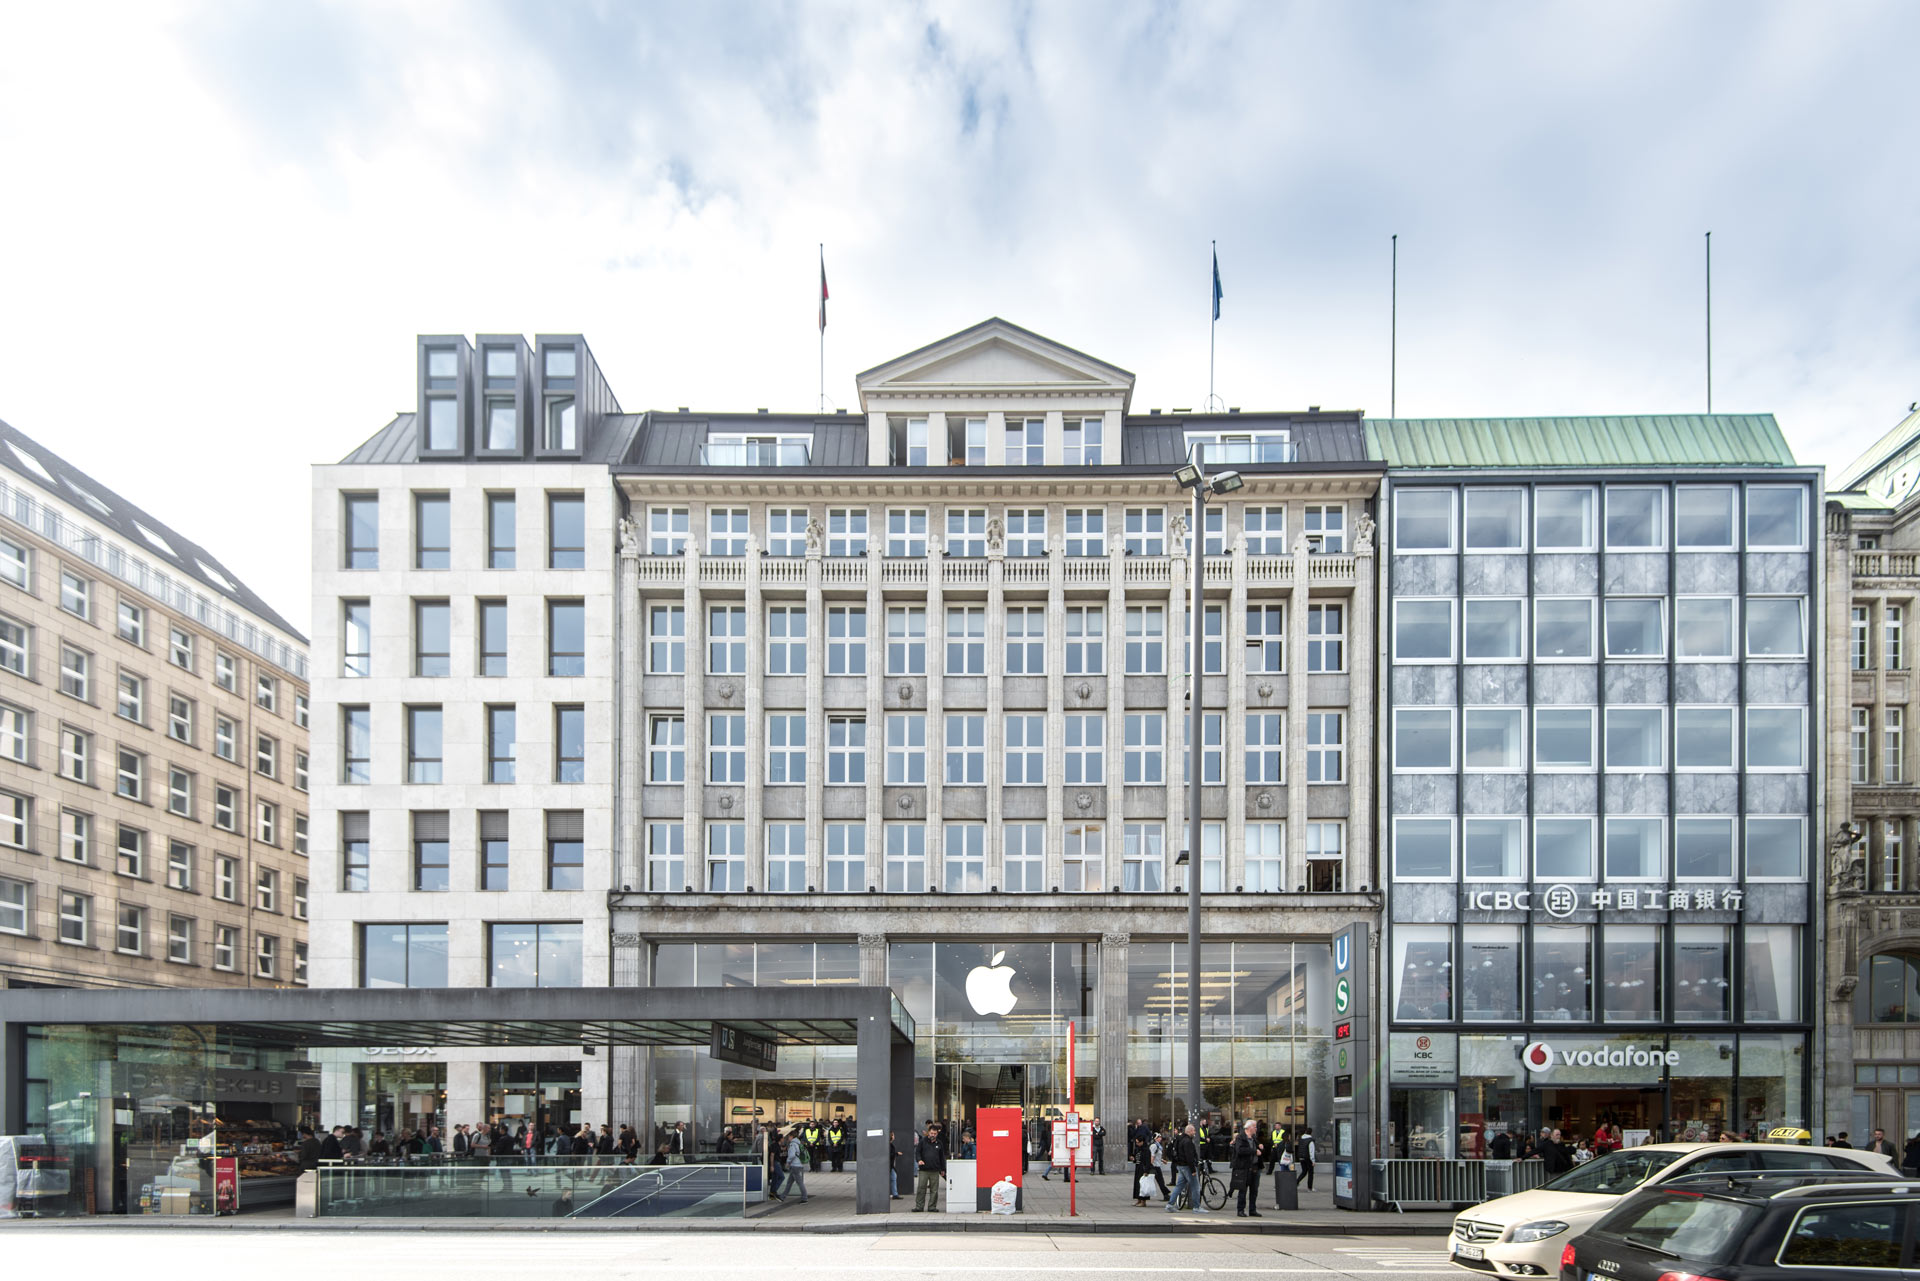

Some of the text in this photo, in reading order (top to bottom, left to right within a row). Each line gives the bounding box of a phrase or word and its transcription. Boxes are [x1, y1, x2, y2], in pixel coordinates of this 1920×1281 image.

[1469, 891, 1530, 910] ICBC
[1591, 888, 1743, 911] 中国工商银行
[1336, 935, 1348, 970] U
[1337, 980, 1348, 1012] S
[1561, 1045, 1680, 1067] vodafone
[1771, 1128, 1799, 1137] TAXI
